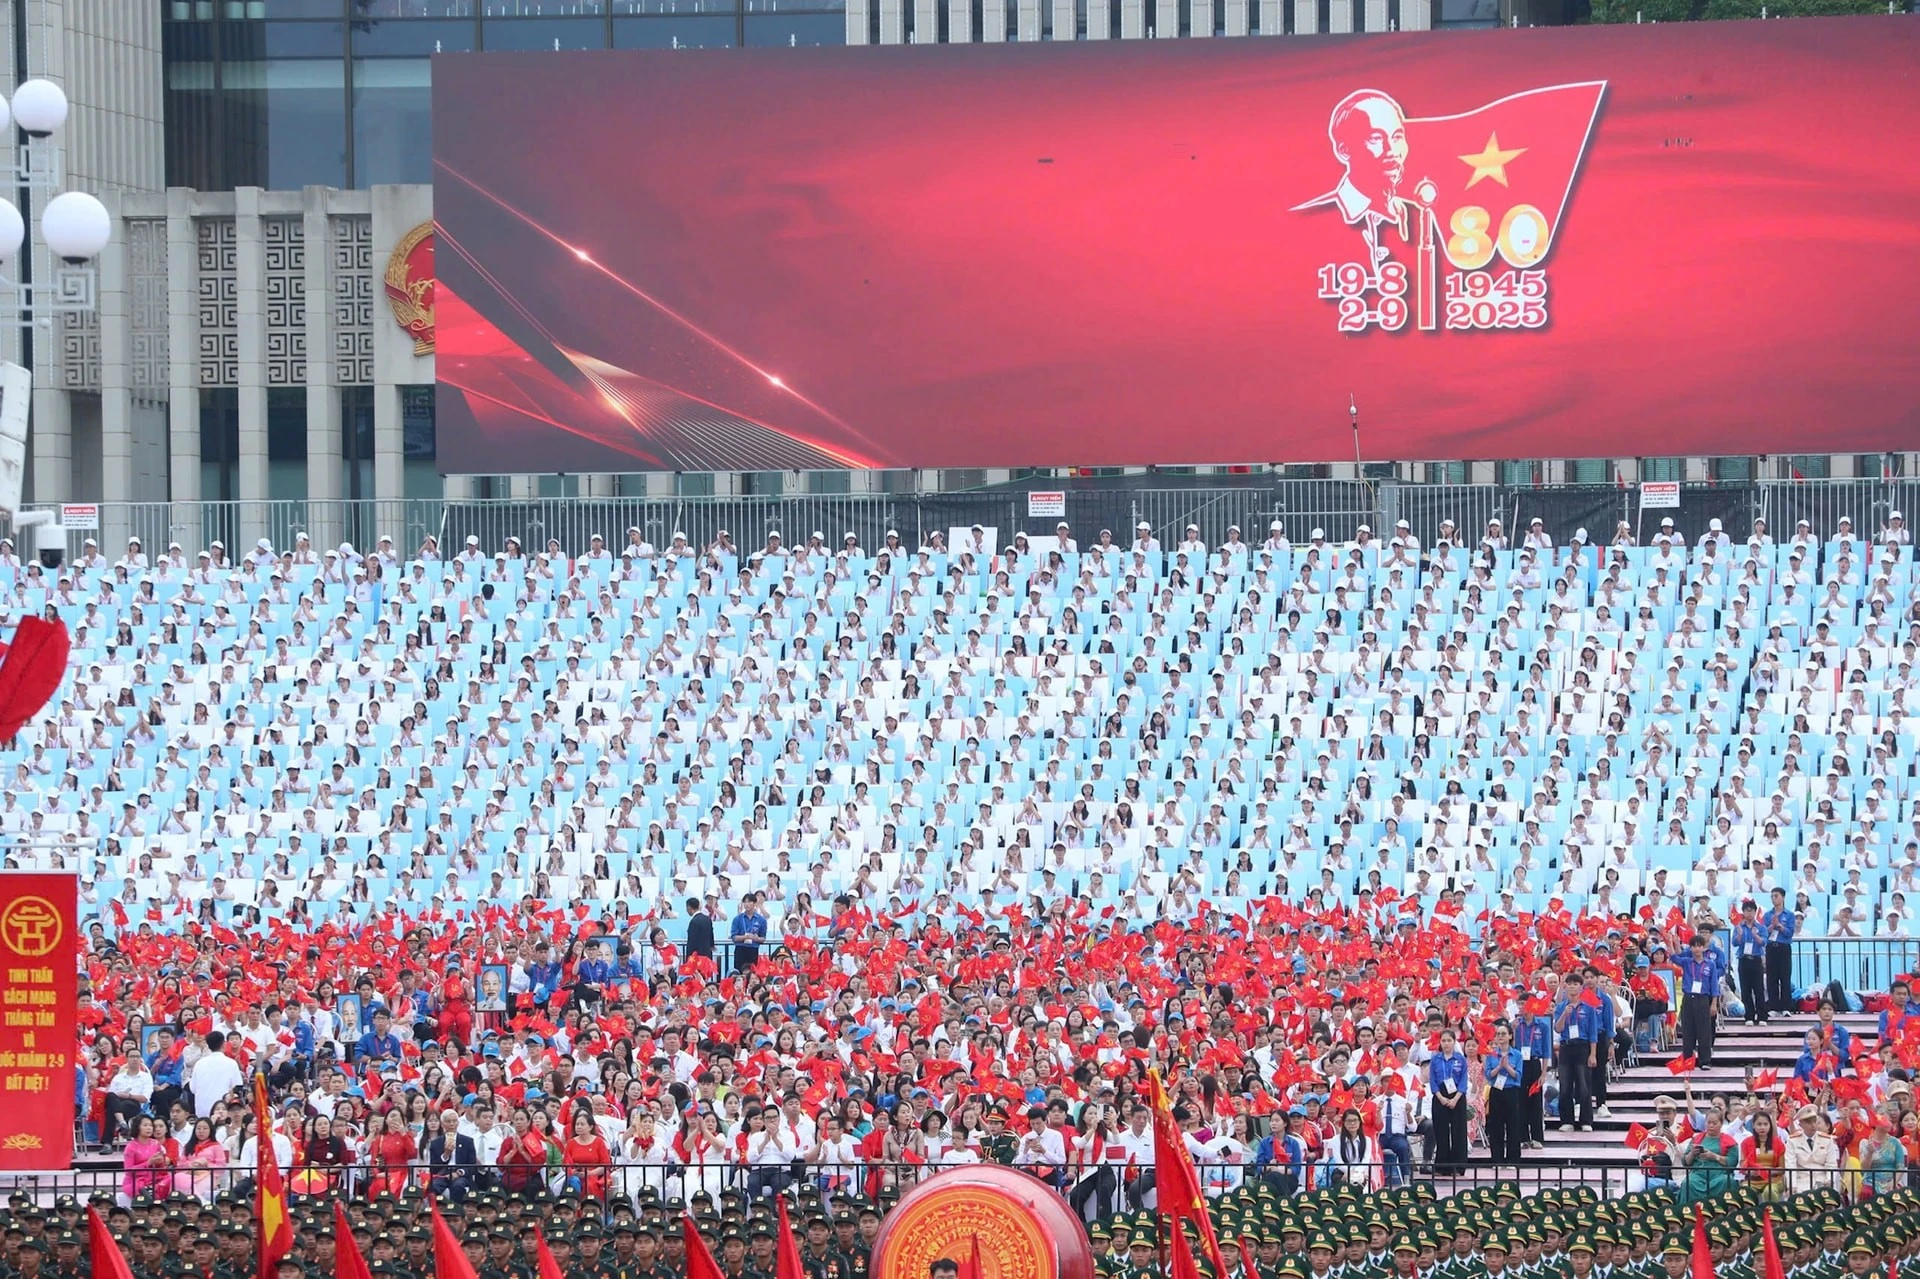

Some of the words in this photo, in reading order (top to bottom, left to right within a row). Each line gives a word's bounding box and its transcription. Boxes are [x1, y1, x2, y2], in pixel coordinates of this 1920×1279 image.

[1448, 204, 1550, 269] 80
[1317, 262, 1408, 298] 19-8
[1445, 270, 1548, 299] 1945
[1337, 296, 1409, 331] 2-9
[1445, 297, 1548, 329] 2025
[3, 987, 28, 1005] CÁCH
[29, 990, 56, 1007] MẠNG
[5, 1009, 33, 1026] THÁNG
[48, 1053, 64, 1067] 2-9
